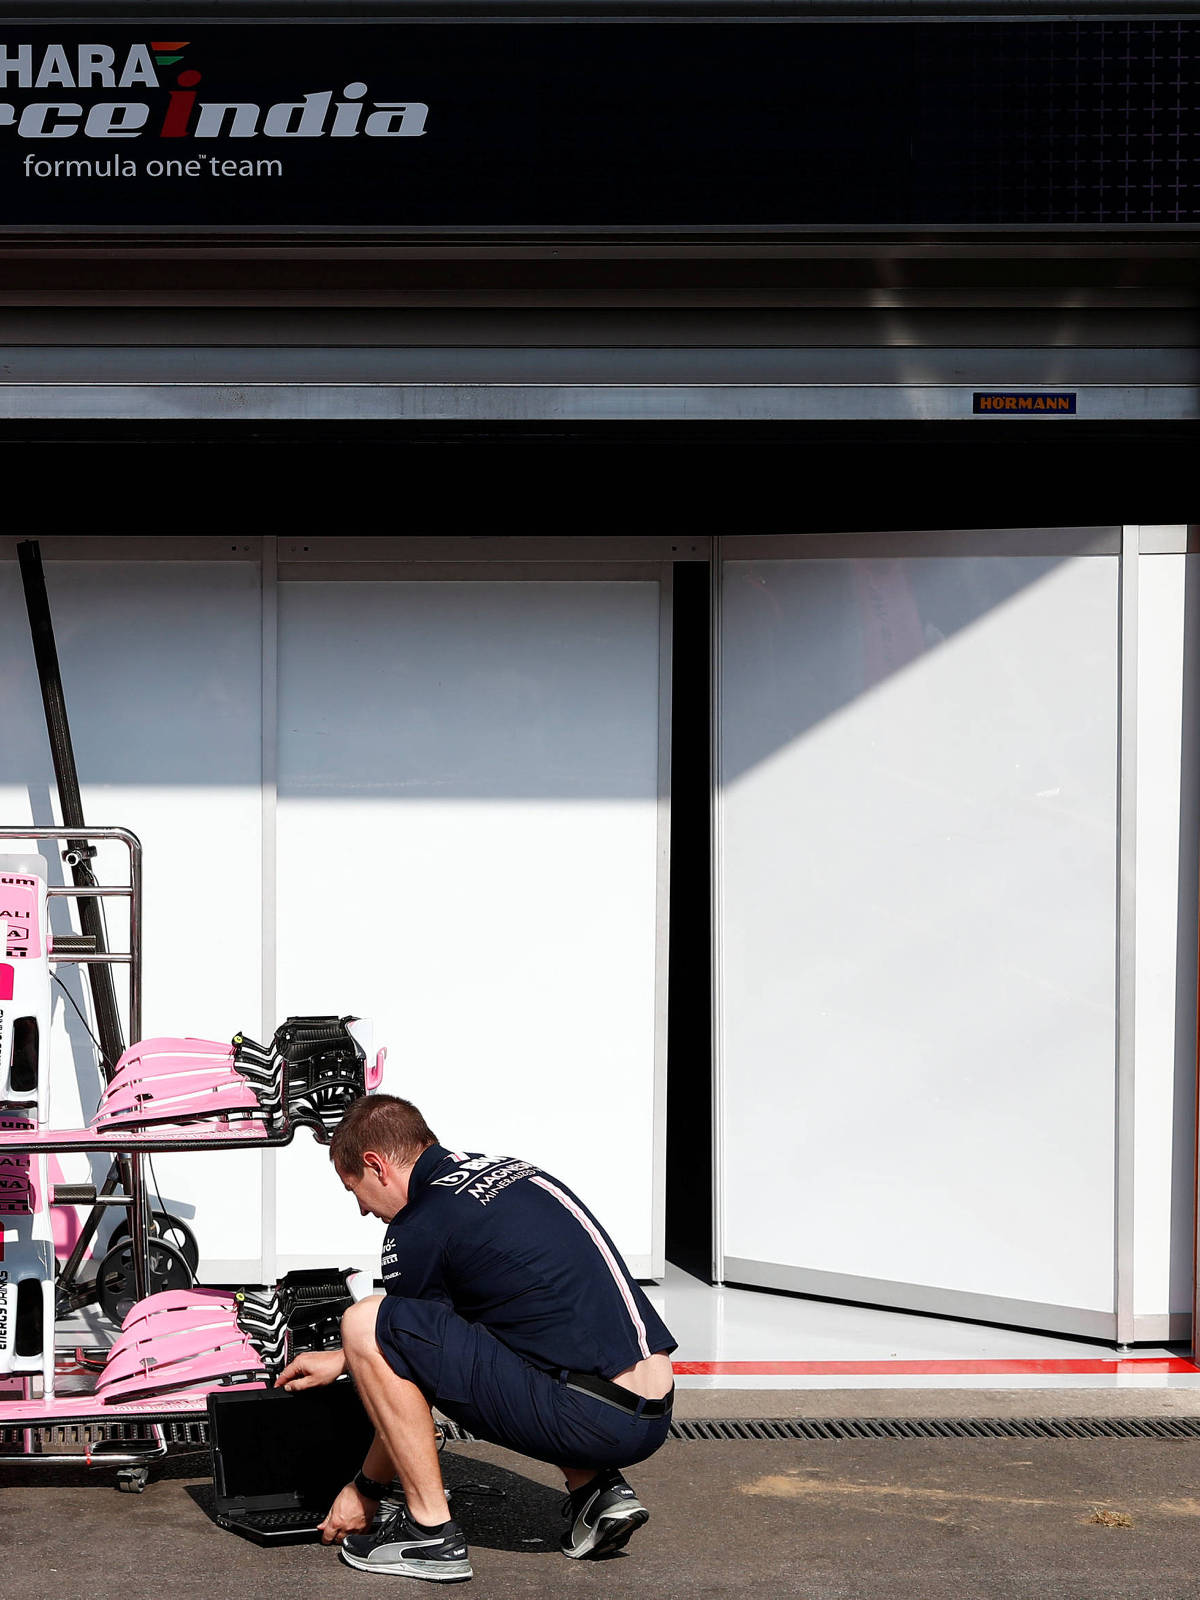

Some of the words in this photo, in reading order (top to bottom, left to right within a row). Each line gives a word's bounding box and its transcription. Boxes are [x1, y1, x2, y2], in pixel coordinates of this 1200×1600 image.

[23, 153, 137, 177] formula
[208, 157, 283, 177] team
[979, 395, 1070, 410] HÖRMANN
